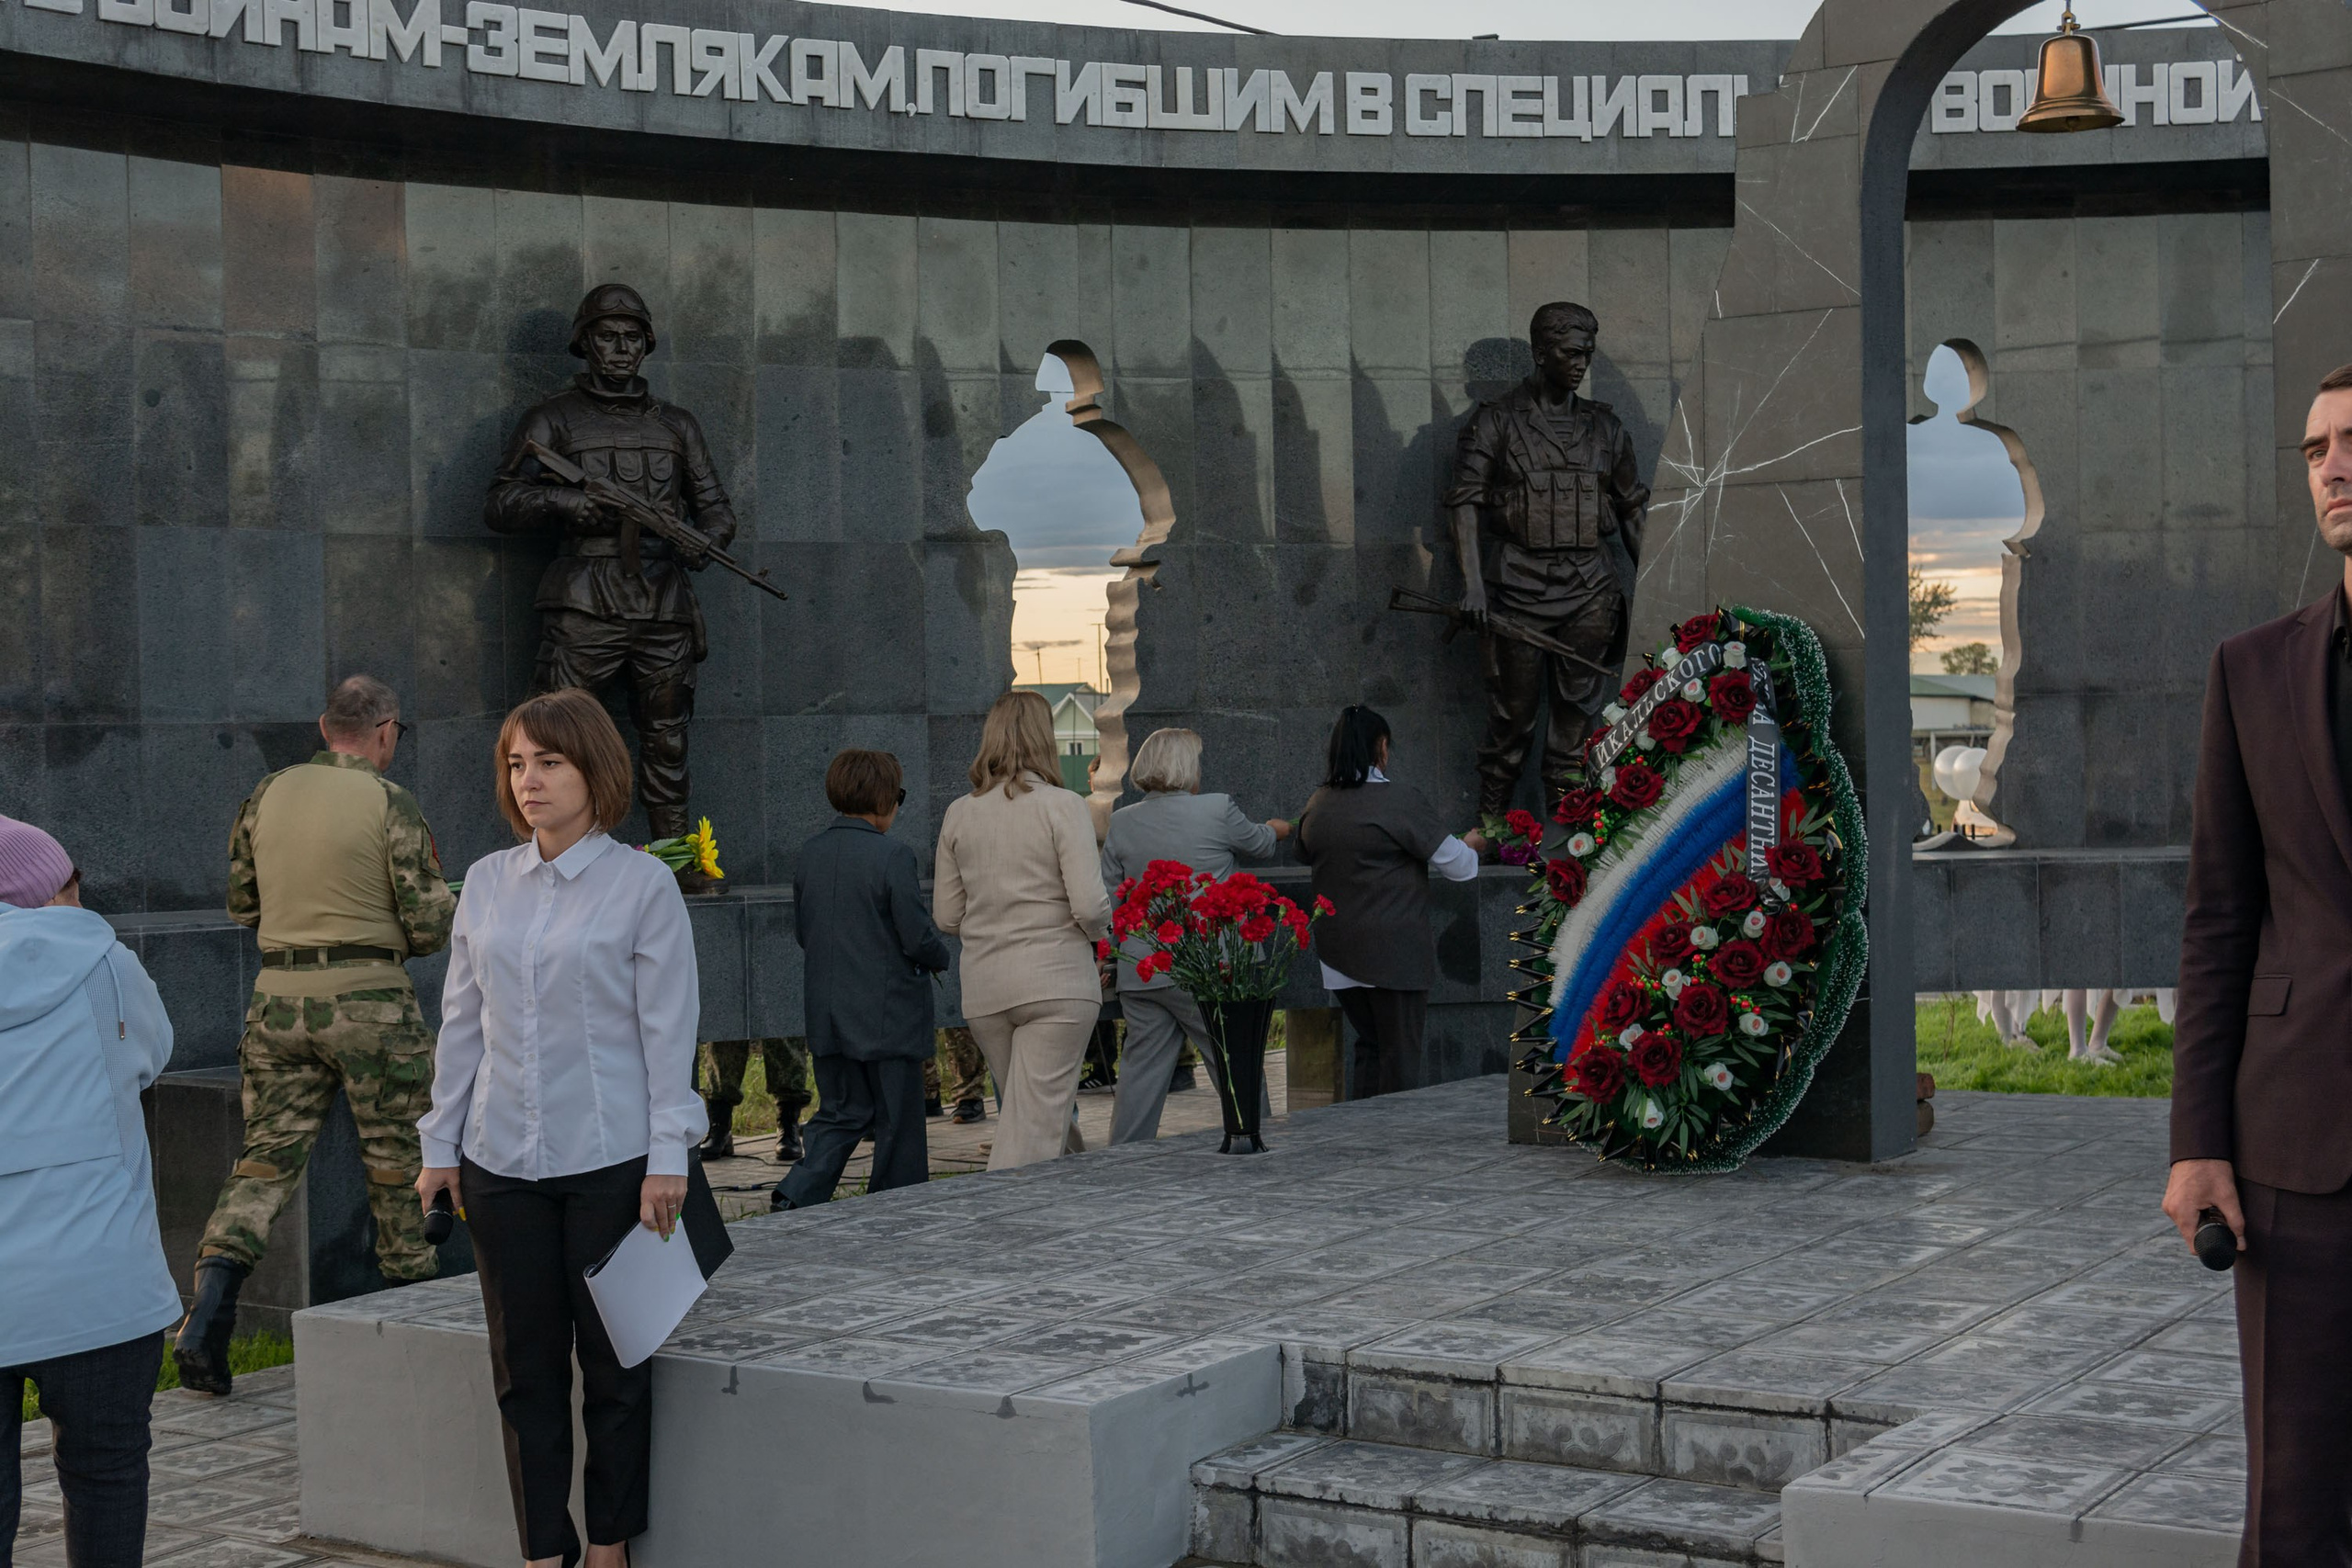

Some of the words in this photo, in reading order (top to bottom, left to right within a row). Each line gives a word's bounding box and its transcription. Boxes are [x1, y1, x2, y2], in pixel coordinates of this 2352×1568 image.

[916, 48, 1334, 135] ПОГИБШИМ
[1346, 72, 1392, 137] В
[1405, 73, 1747, 142] СПЕЦИАЛ
[1931, 53, 2262, 133] ВОНОЙ
